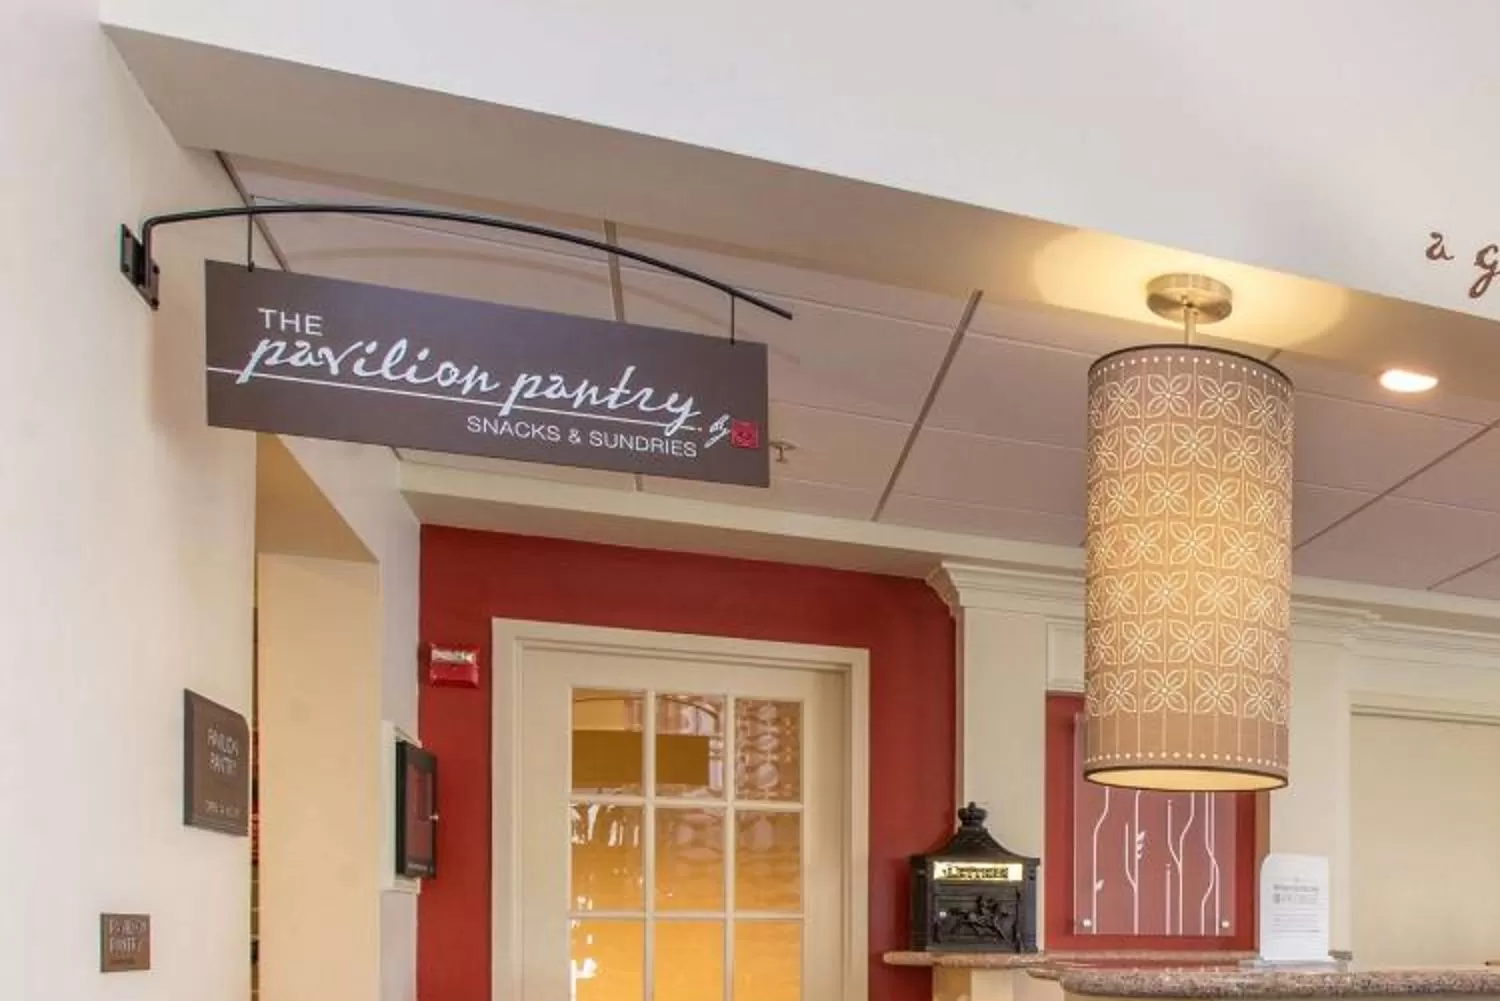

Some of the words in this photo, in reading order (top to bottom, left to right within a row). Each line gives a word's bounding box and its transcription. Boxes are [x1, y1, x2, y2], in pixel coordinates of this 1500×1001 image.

[1425, 231, 1454, 261] a
[257, 307, 324, 337] THE
[235, 337, 501, 396] pavilion
[498, 364, 701, 437] pantry
[466, 415, 562, 442] SNACKS
[568, 428, 583, 445] &
[588, 429, 698, 458] SUNDRIES
